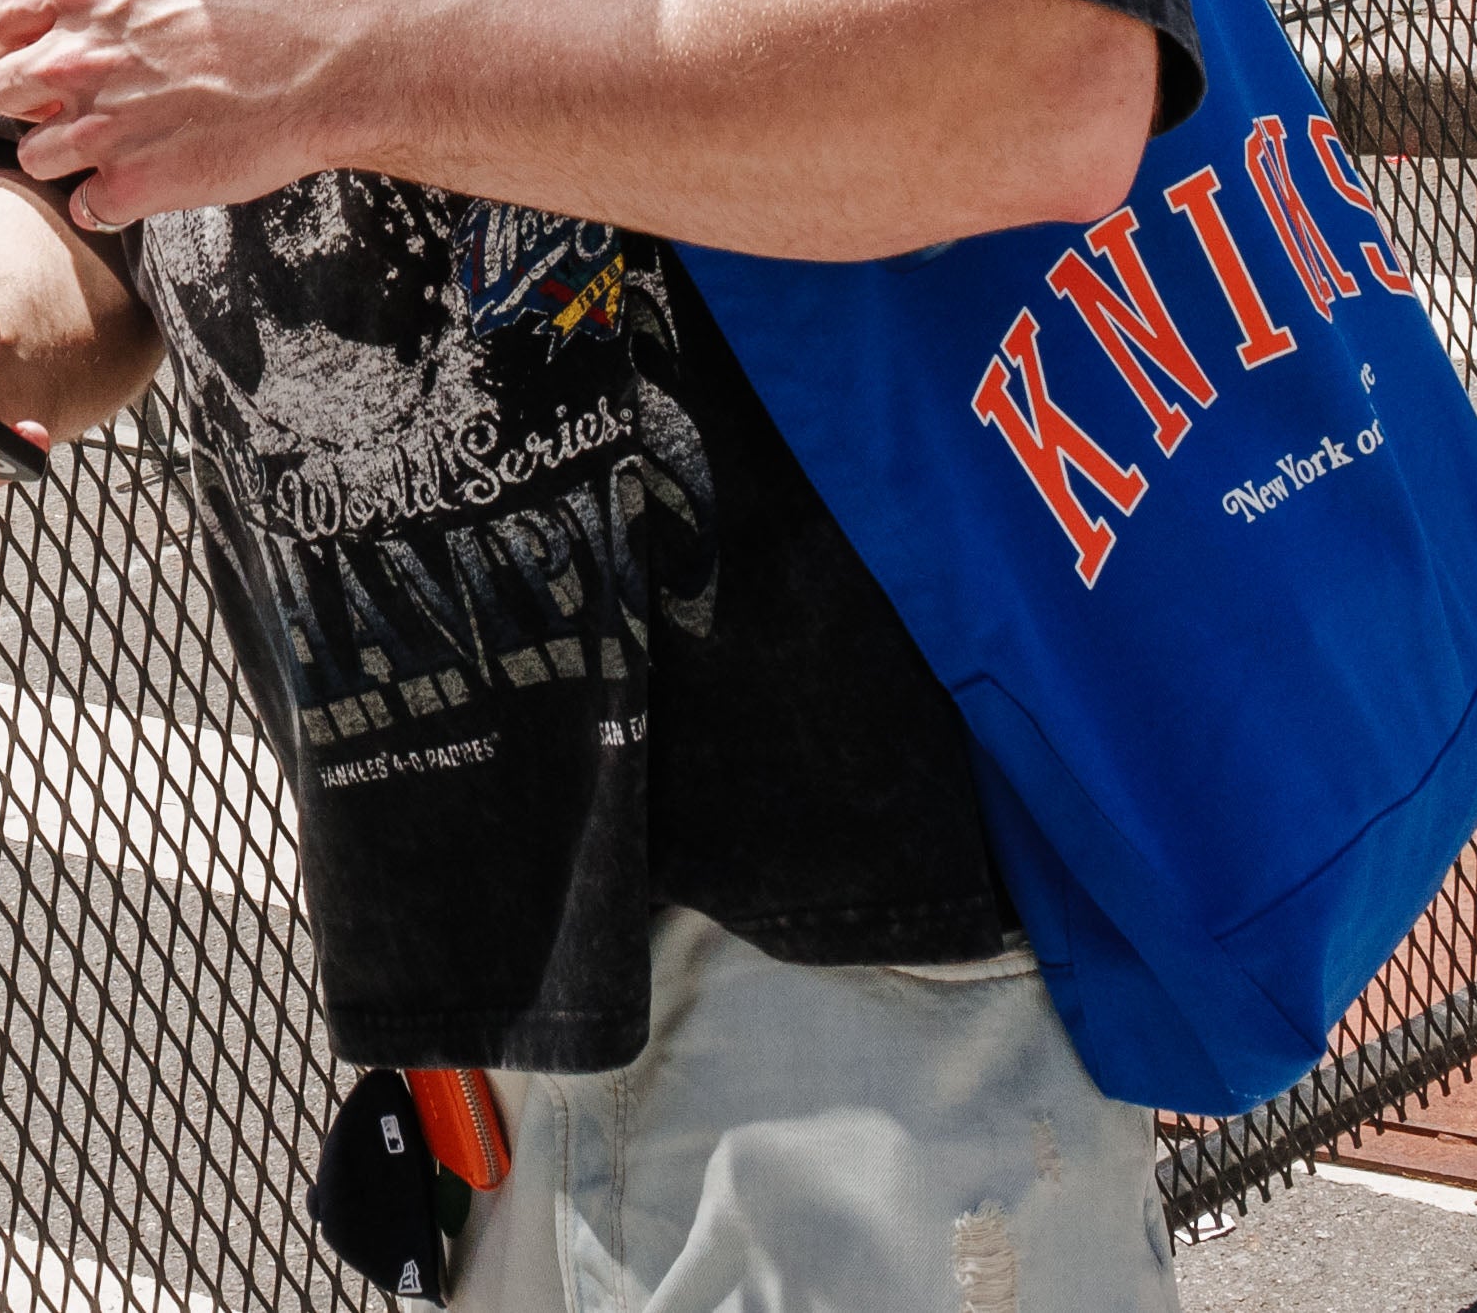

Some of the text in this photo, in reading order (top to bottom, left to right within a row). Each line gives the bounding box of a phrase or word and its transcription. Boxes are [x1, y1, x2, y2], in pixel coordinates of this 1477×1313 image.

[276, 419, 461, 540] World
[1222, 480, 1289, 523] New
[1276, 436, 1354, 490] York
